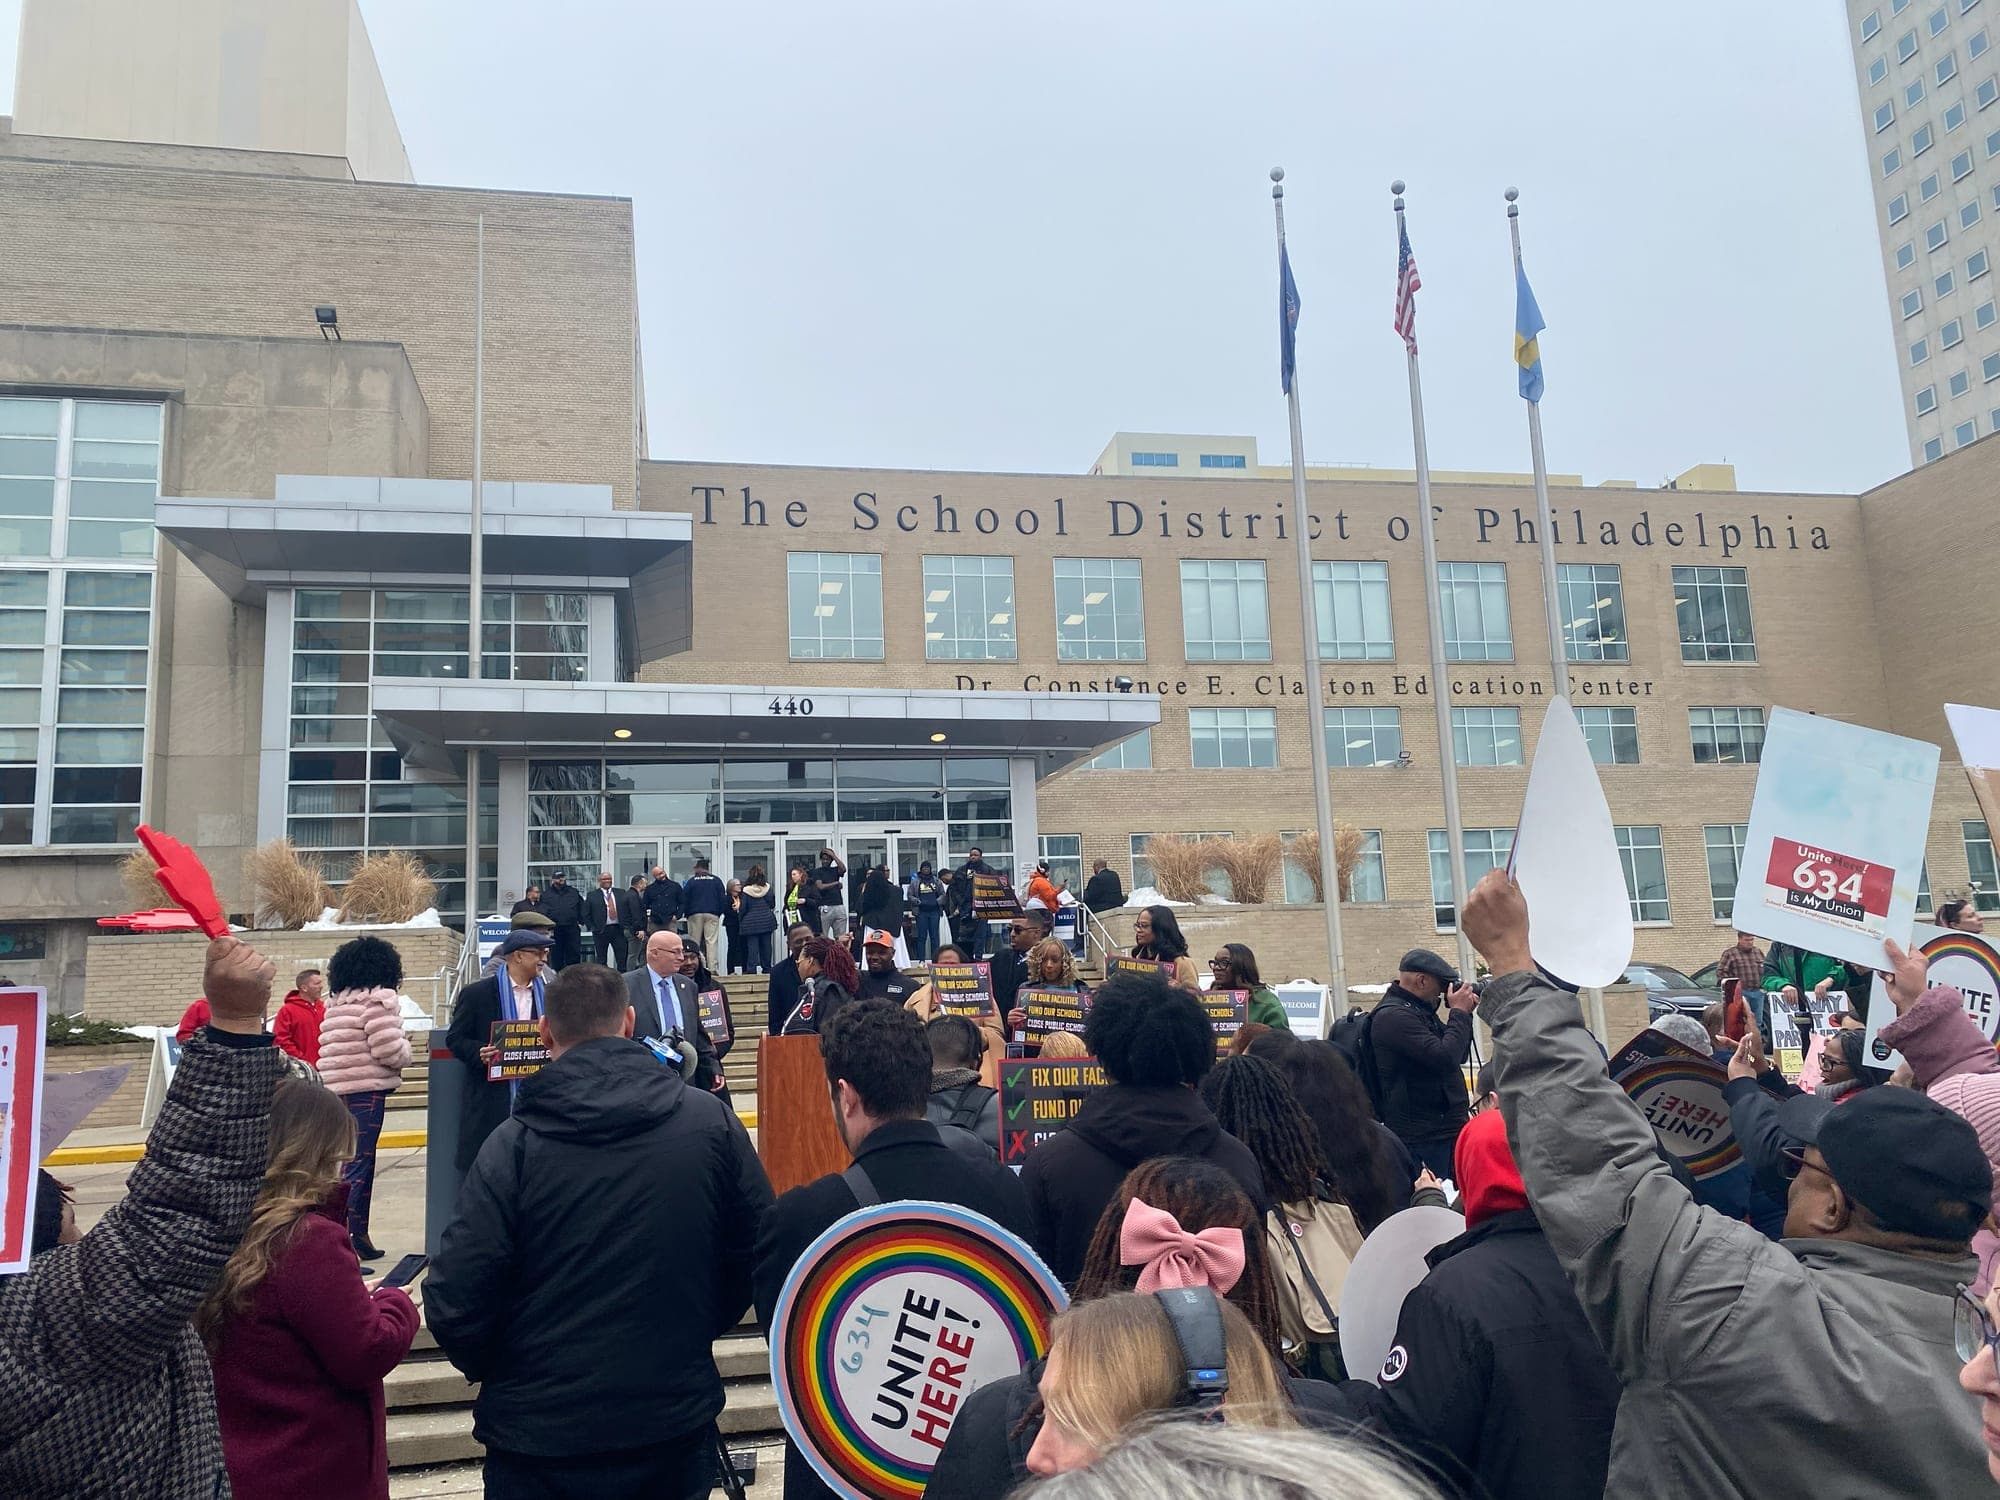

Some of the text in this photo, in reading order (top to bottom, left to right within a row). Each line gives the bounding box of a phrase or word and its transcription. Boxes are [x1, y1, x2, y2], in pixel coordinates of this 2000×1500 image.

[691, 486, 1831, 558] The School District o Philadelphia
[1023, 675, 1188, 695] Constnce
[1206, 676, 1236, 695] E.
[1255, 676, 1376, 695] Claton
[1392, 676, 1544, 695] Edcation
[768, 698, 814, 716] 440
[1793, 860, 1863, 903] 634
[1790, 891, 1862, 918] is My Union
[1029, 993, 1038, 1002] FIX
[1039, 993, 1050, 1003] OUR
[1280, 1001, 1317, 1009] WELCOME
[1028, 1006, 1083, 1019] FUND OUR SCHOOLS
[505, 1024, 516, 1033] FIX
[516, 1024, 530, 1033] OUR
[1027, 1019, 1044, 1028] CLOSE
[1044, 1020, 1065, 1031] PUBLIC
[504, 1037, 521, 1046] FUND
[522, 1036, 535, 1046] OUR
[503, 1050, 522, 1061] CLOSE
[523, 1049, 546, 1060] PUBLIC
[502, 1065, 517, 1075] TAKE
[1031, 1067, 1050, 1087] FIX
[1053, 1067, 1079, 1086] OUR
[1033, 1099, 1066, 1119] FUND
[1651, 1091, 1728, 1129] HERE!
[1644, 1107, 1714, 1144] UNITE
[840, 1304, 890, 1374] 634
[870, 1288, 941, 1430] UNITE
[910, 1307, 981, 1449] HERE!
